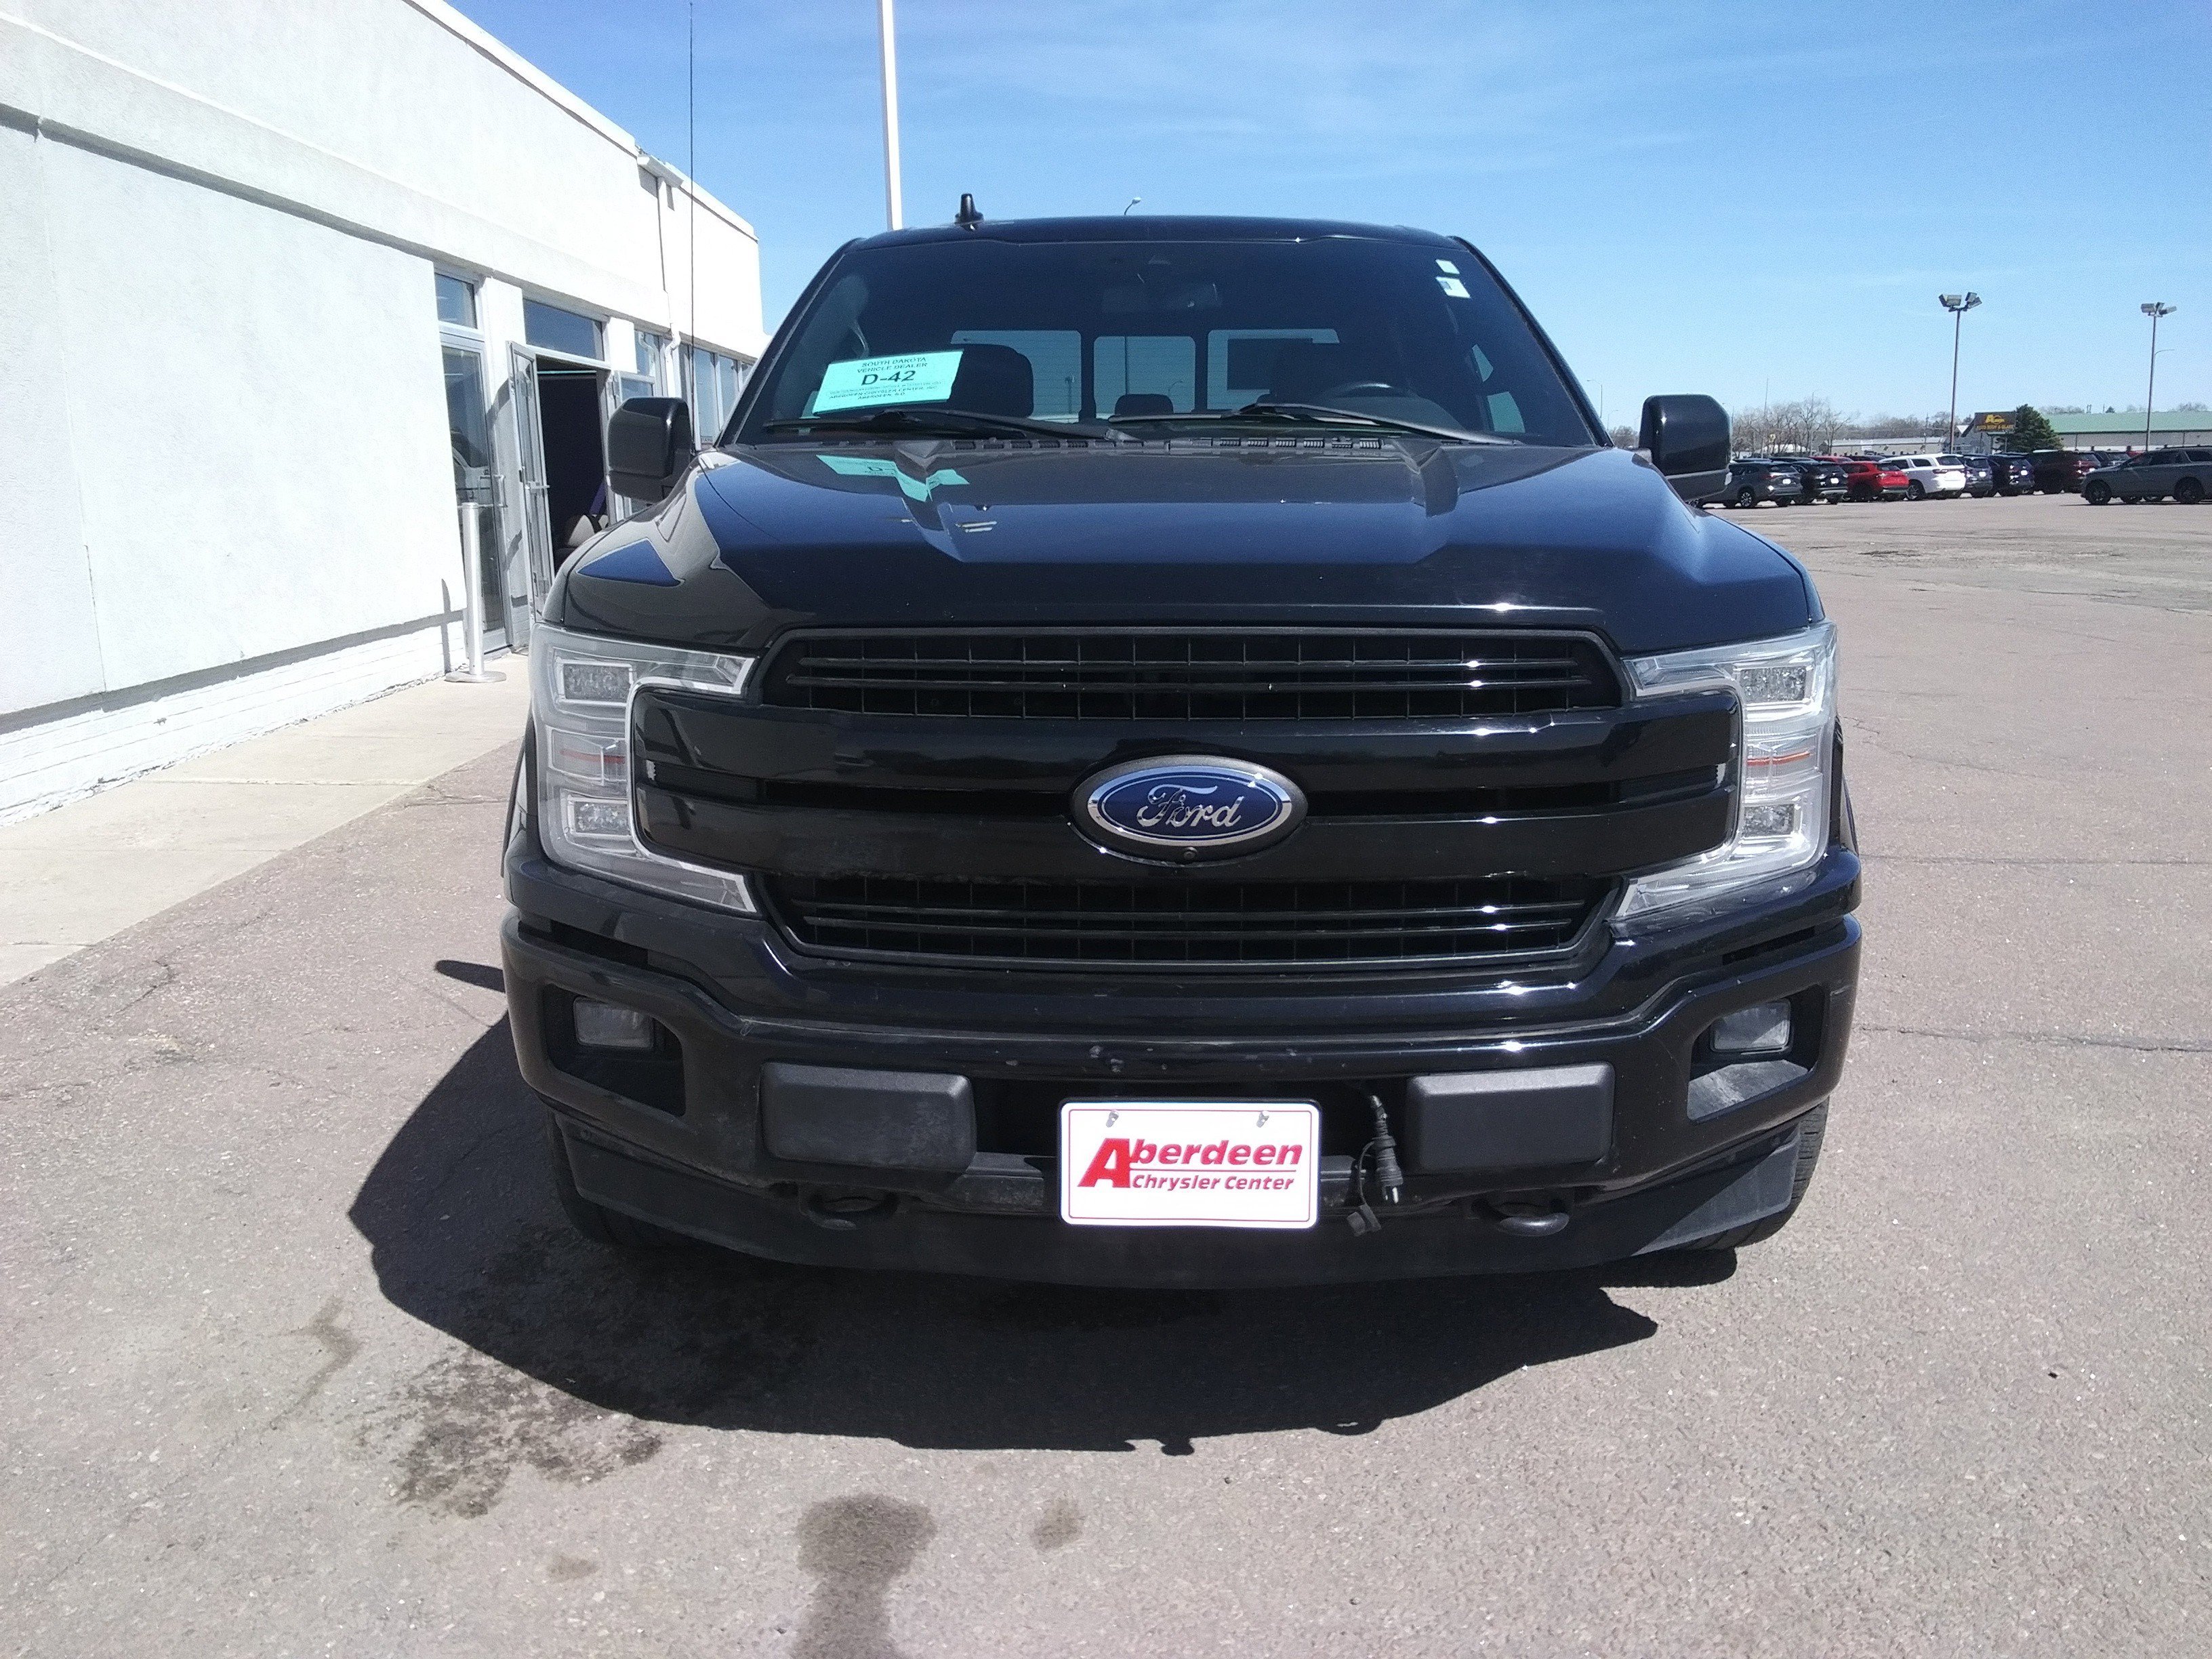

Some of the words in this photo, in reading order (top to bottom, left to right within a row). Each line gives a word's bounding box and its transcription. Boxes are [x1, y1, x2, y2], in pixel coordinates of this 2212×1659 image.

[892, 356, 926, 365] DAKOTA
[857, 365, 892, 373] VEHICLE
[861, 370, 916, 386] D-42
[1136, 783, 1246, 828] Ford
[1077, 1137, 1303, 1188] Aberdeen
[1132, 1174, 1221, 1191] Chrysler
[1224, 1175, 1295, 1191] Center
